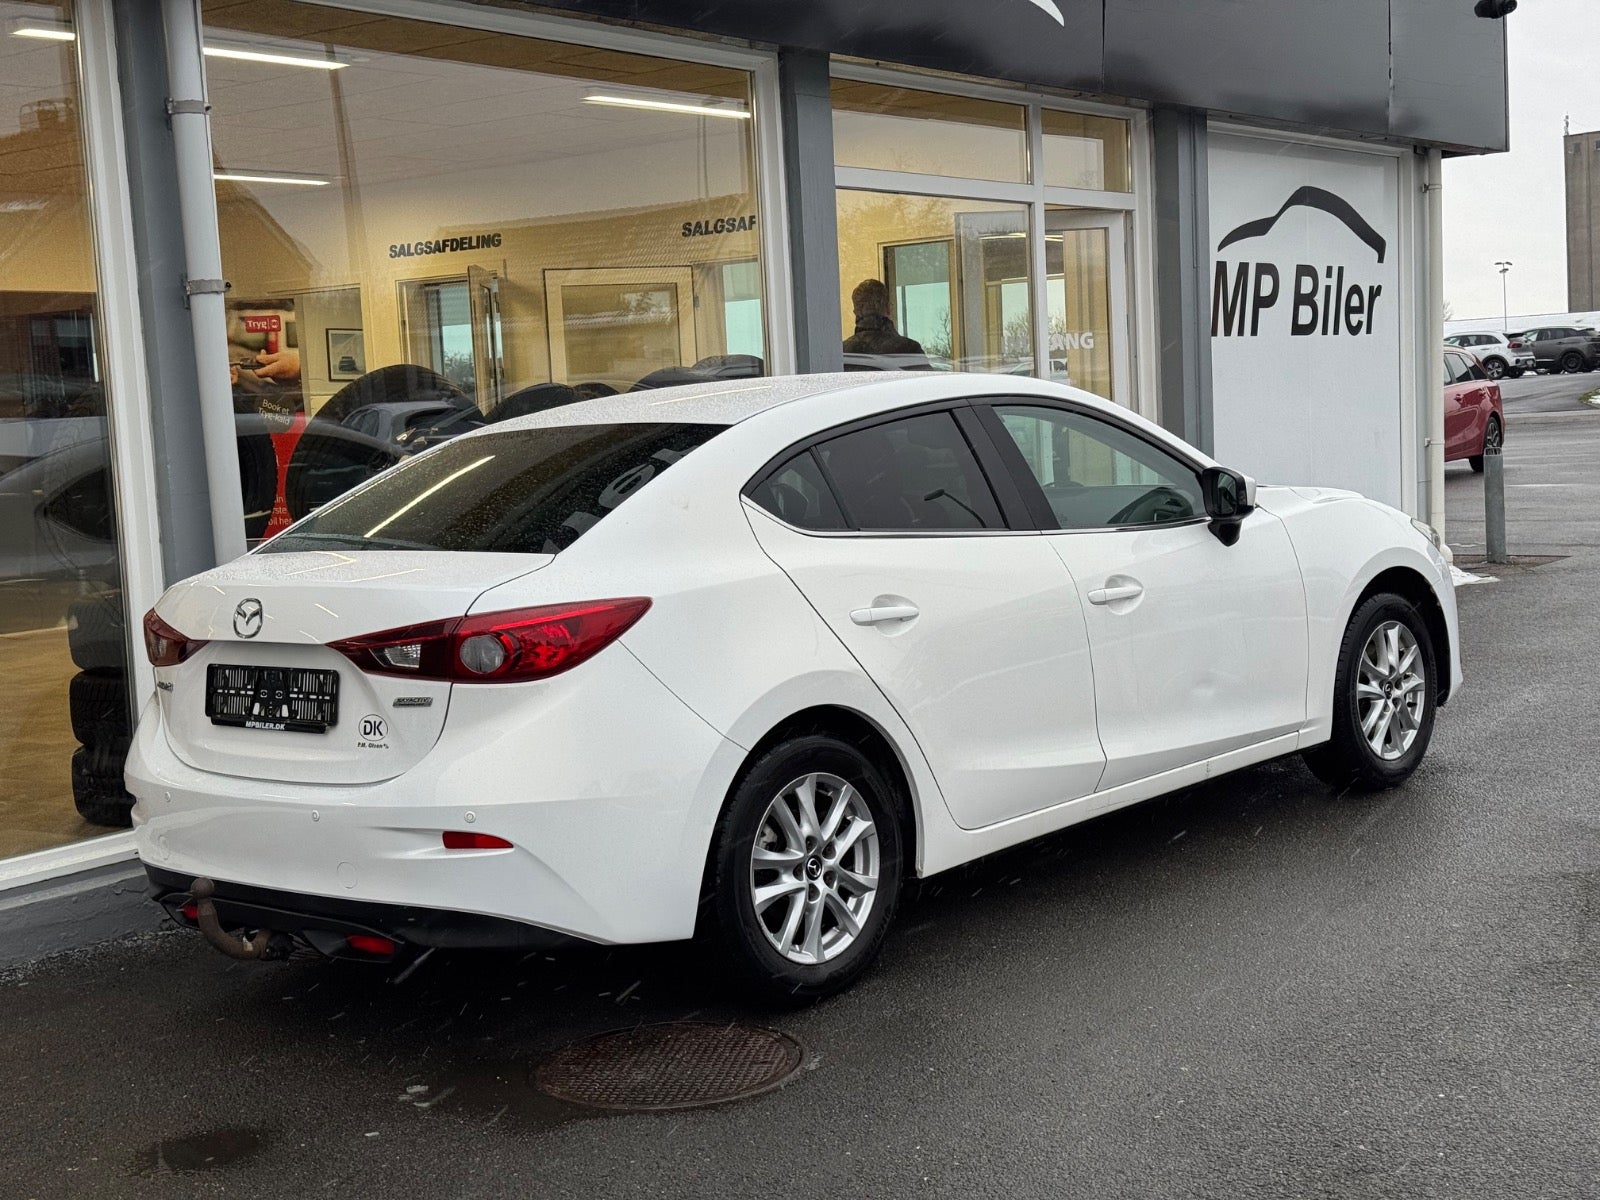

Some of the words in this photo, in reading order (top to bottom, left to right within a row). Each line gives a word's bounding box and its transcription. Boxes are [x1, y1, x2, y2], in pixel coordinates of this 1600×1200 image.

[682, 215, 756, 237] SALGSAF
[389, 233, 502, 258] SALGSAFDELING
[1211, 260, 1279, 337] MP
[1291, 264, 1382, 336] Biler
[247, 320, 267, 330] Tryg
[1049, 331, 1095, 350] ANG
[262, 399, 282, 412] Book
[245, 721, 285, 730] MPBILER.DK
[363, 720, 384, 736] DK
